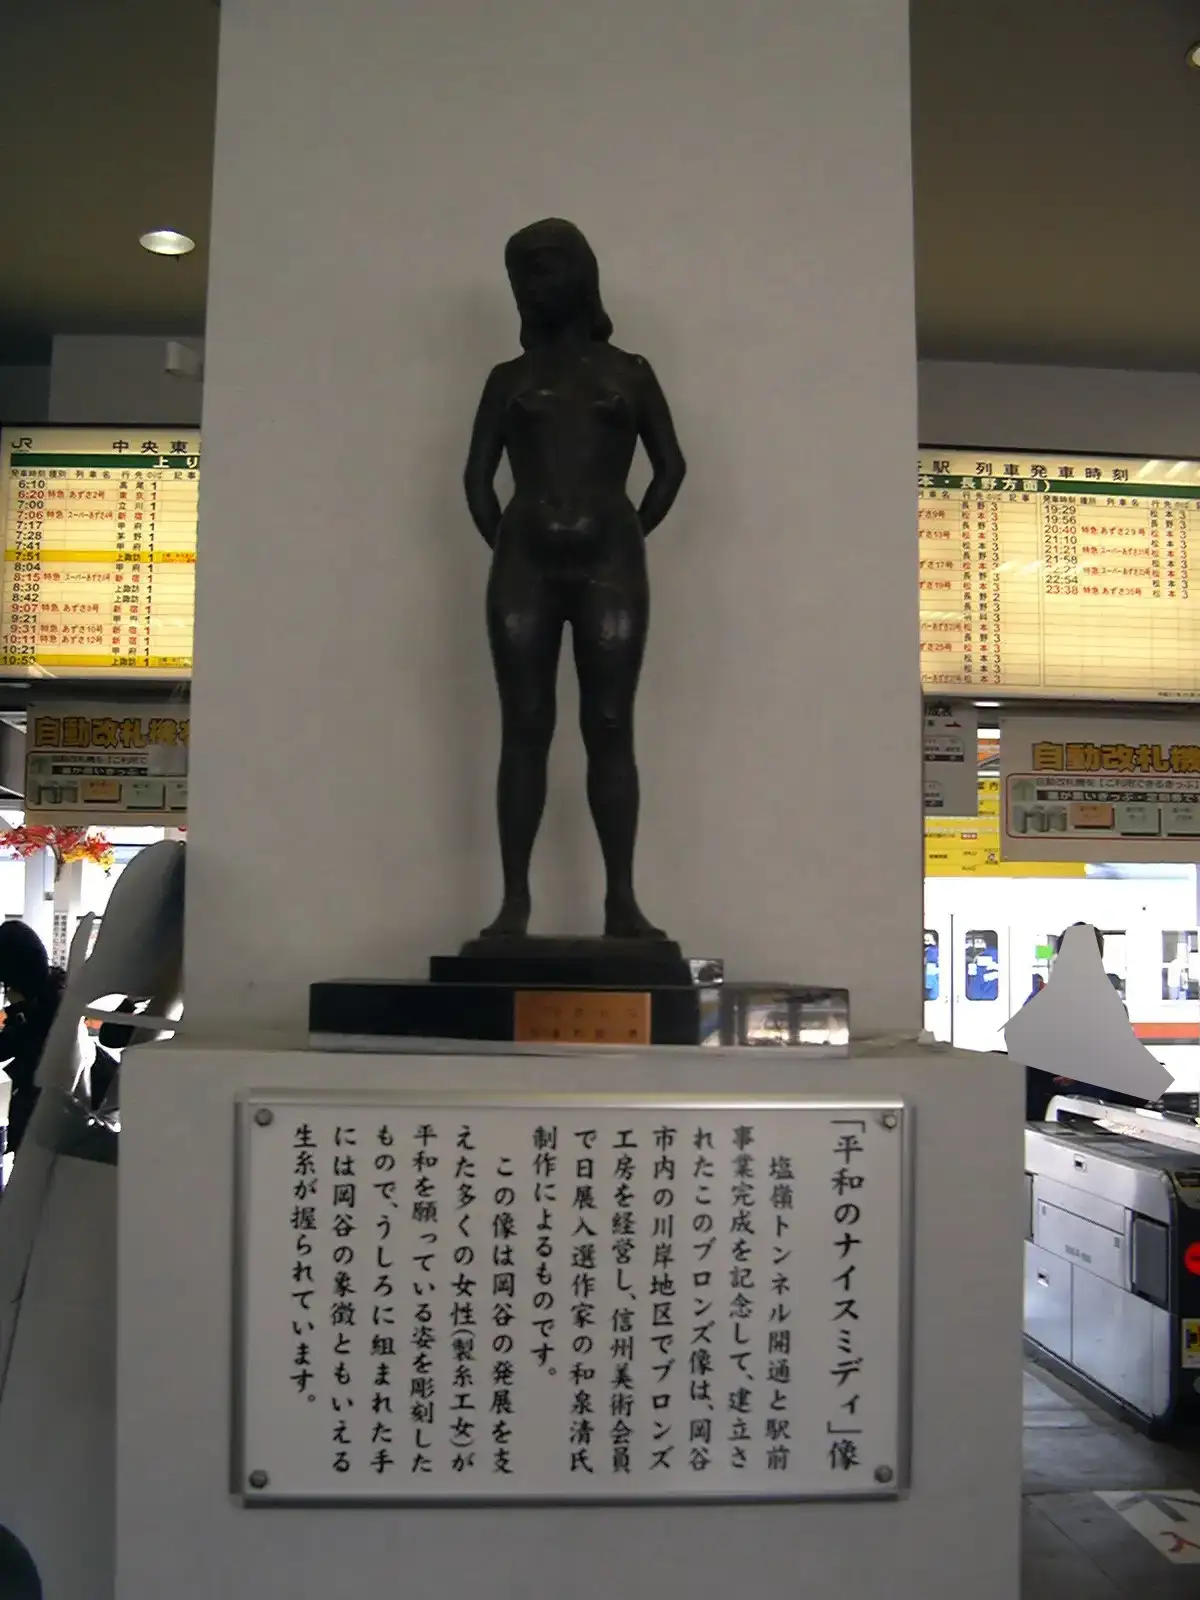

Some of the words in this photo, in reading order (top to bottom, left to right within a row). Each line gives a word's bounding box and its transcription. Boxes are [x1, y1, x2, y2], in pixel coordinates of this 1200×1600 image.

[11, 437, 33, 449] JR
[112, 439, 201, 454] 中央東
[153, 456, 200, 469] 上り
[918, 461, 950, 474] 駅
[976, 462, 1128, 481] 列車発車時刻
[19, 480, 46, 489] 6:10
[151, 482, 156, 490] 1
[918, 475, 1050, 491] 本・長野方面)
[18, 490, 46, 499] 6:20
[151, 492, 156, 500] 1
[18, 500, 44, 509] 7:00
[118, 502, 143, 510] 立川
[151, 502, 155, 510] 1
[991, 501, 998, 511] 3
[991, 512, 998, 521] 3
[1045, 505, 1076, 515] 19:29
[1177, 510, 1186, 520] 3
[17, 521, 43, 529] 7:17
[118, 522, 142, 530] 甲府
[992, 522, 998, 531] 3
[1045, 515, 1076, 524] 19:56
[1179, 520, 1186, 529] 3
[16, 531, 42, 540] 7:28
[149, 533, 154, 541] 1
[992, 532, 998, 541] 3
[1045, 525, 1076, 534] 20:40
[1101, 527, 1145, 536] あずさ29号
[1180, 530, 1186, 540] 3
[16, 541, 40, 550] 7:41
[992, 543, 999, 551] 3
[1045, 535, 1077, 544] 21:10
[1180, 540, 1187, 549] 3
[15, 551, 40, 561] 7:51
[148, 554, 153, 562] 1
[992, 553, 999, 561] 3
[1045, 545, 1076, 555] 21:21
[1180, 550, 1187, 559] 3
[14, 562, 41, 572] 8:04
[116, 563, 140, 572] 甲府
[148, 564, 153, 572] 1
[1045, 555, 1077, 564] 21:58
[1181, 560, 1187, 569] 3
[14, 573, 41, 582] 8:15
[148, 575, 152, 583] 1
[993, 573, 1000, 581] 3
[1181, 570, 1188, 579] 3
[1045, 575, 1078, 584] 22:54
[1182, 580, 1188, 589] 3
[13, 583, 40, 592] 8:30
[115, 585, 139, 593] 上諏訪
[147, 585, 152, 593] 1
[993, 583, 1000, 592] 3
[1046, 585, 1078, 595] 23:38
[1182, 590, 1188, 599] 3
[12, 593, 39, 602] 8:42
[993, 593, 1000, 602] 2
[11, 603, 40, 613] 9:07
[145, 606, 151, 614] 1
[993, 603, 1000, 612] 3
[12, 614, 36, 624] 9:21
[994, 613, 1000, 622] 3
[11, 624, 39, 634] 9:31
[145, 627, 150, 635] 1
[994, 624, 1000, 632] 3
[3, 634, 39, 644] 10:11
[62, 635, 102, 644] あずさ12号
[144, 637, 149, 645] 1
[994, 634, 1000, 643] 3
[3, 645, 35, 654] 10:21
[994, 644, 1000, 653] 3
[144, 658, 149, 667] 1
[994, 654, 1000, 663] 3
[994, 664, 1000, 673] 3
[994, 675, 1000, 684] 3
[530, 1125, 567, 1376] 制作によるものです。
[288, 1124, 318, 1402] 生糸が握られています。
[330, 1126, 357, 1474] には岡谷の象徴ともいえる
[369, 1124, 399, 1474] もので、うしろに組まれた手
[409, 1124, 439, 1474] 平和を願っている姿を彫刻した
[450, 1124, 477, 1473] えた多くの女性(製糸工女)が
[649, 1125, 678, 1470] 市内の川岸地区でブロンズ
[688, 1126, 718, 1472] れたこのブロンズ像は、岡谷
[727, 1125, 757, 1469] 事業完成を記念して、建立さ
[826, 1119, 866, 1472] 「平和のナイスミディ」像
[569, 1128, 598, 1474] で日展入選作家の和泉清氏
[609, 1129, 638, 1474] 工房を経営し、信州美術会員
[490, 1156, 517, 1475] この像は岡谷の発展を支
[763, 1155, 796, 1471] 塩嶺トンネル開通と駅前
